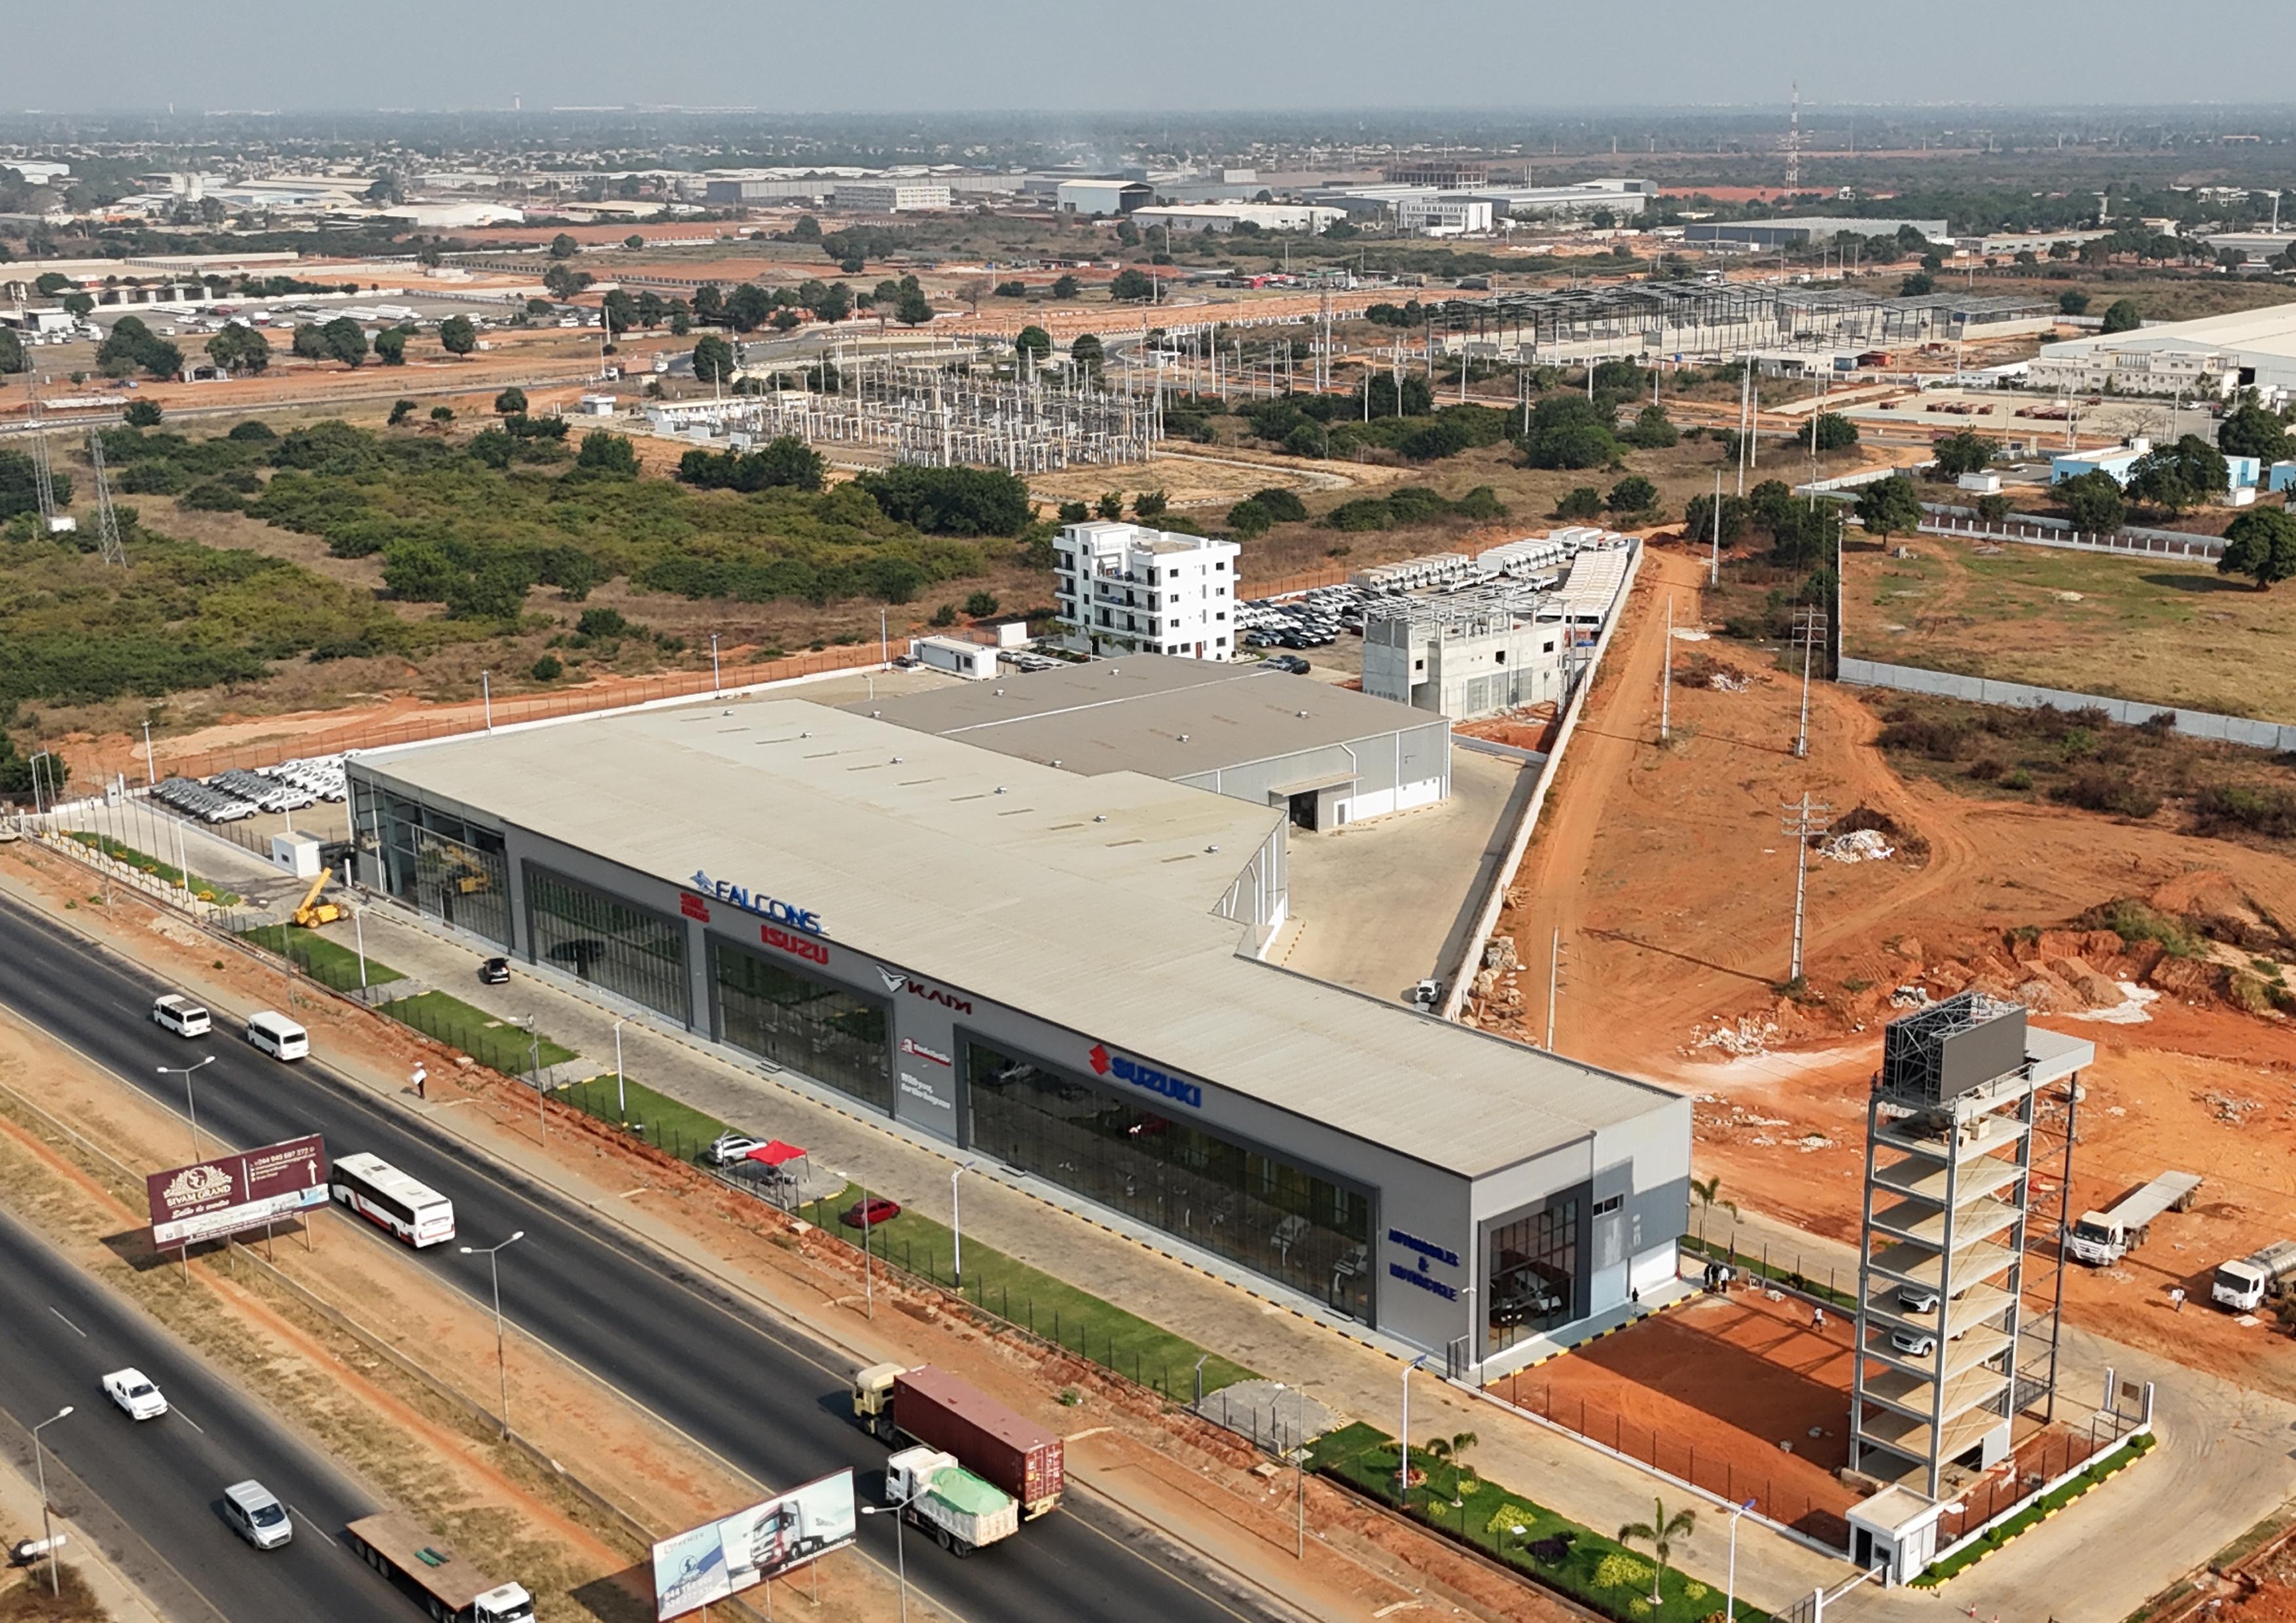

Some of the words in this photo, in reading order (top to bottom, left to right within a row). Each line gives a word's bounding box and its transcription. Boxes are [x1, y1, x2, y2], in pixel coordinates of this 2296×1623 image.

[716, 880, 821, 934] FALCONS
[761, 925, 829, 965] ISUZU
[1112, 1056, 1201, 1108] SUZUKI
[167, 1193, 196, 1207] SIVAM
[198, 1185, 231, 1199] GRAND
